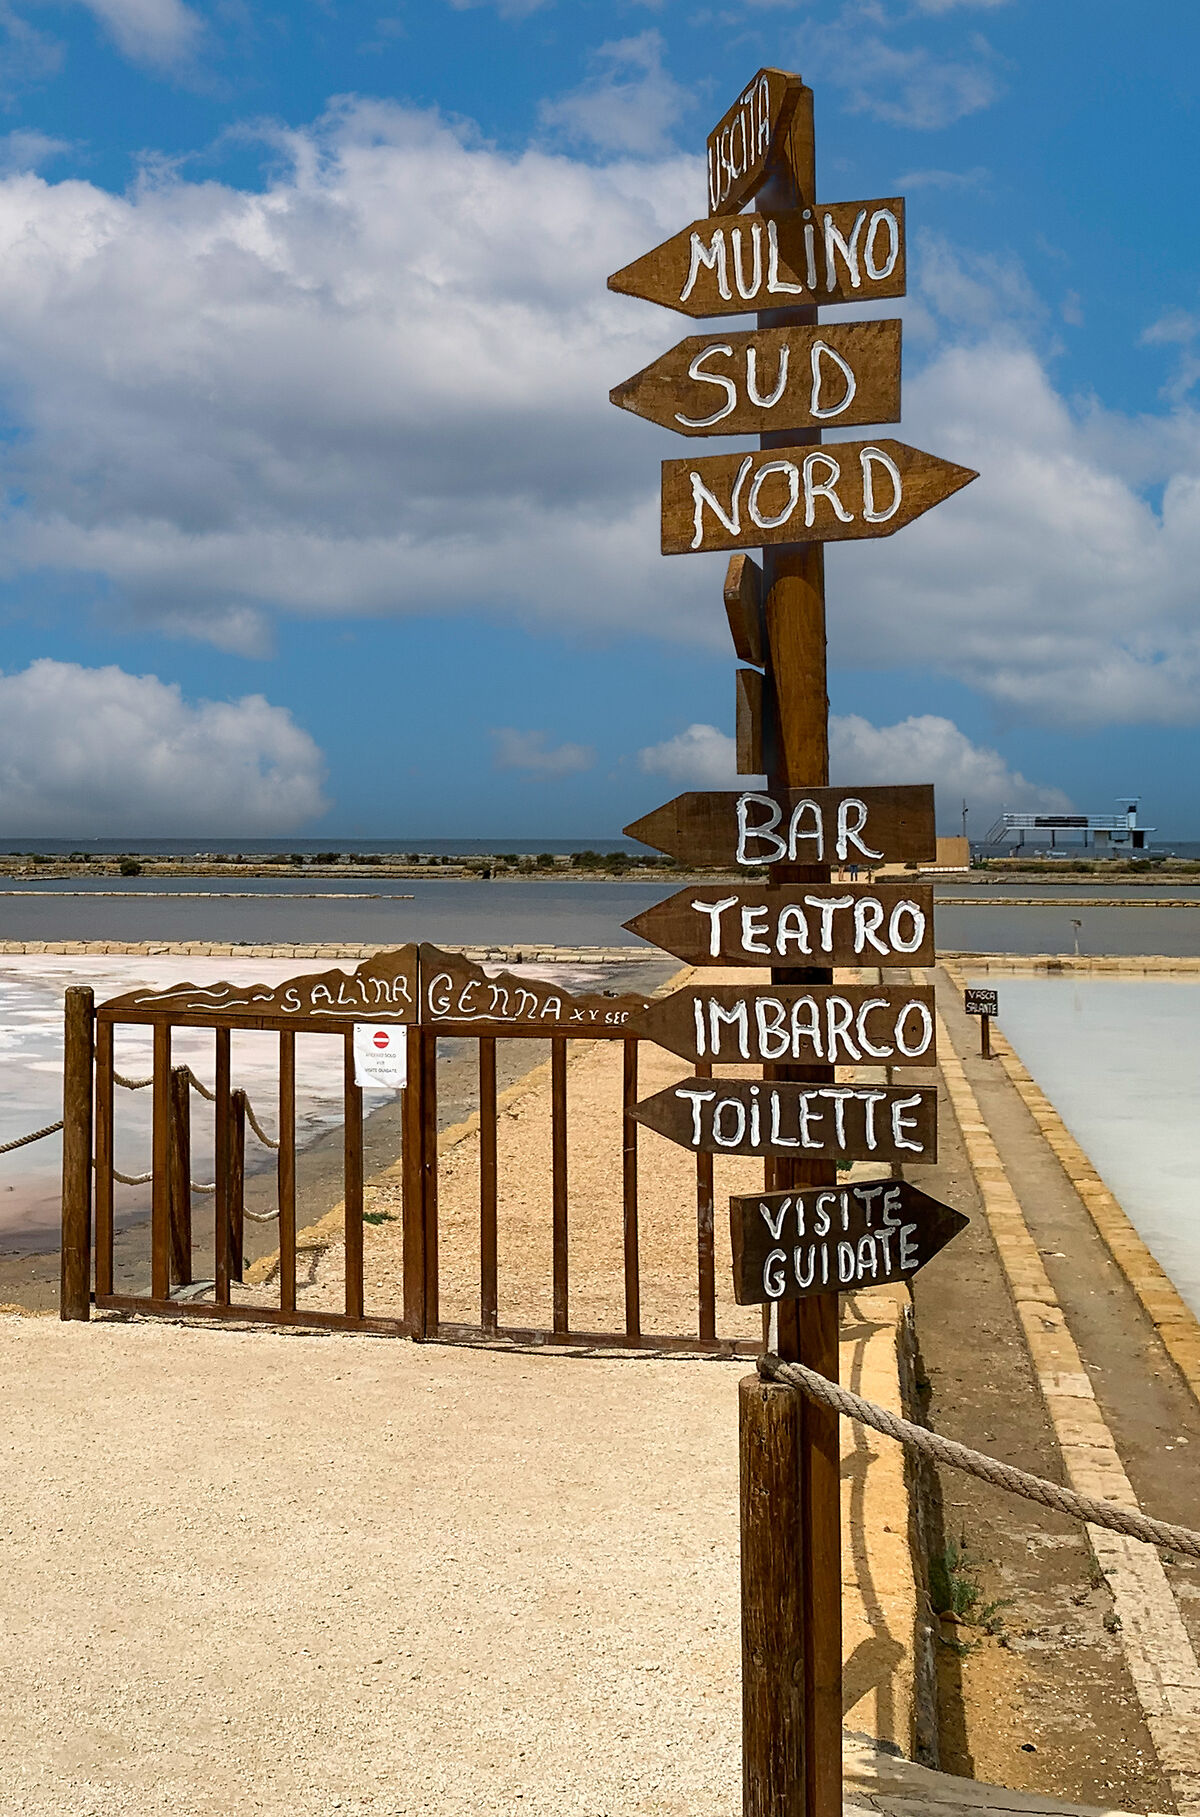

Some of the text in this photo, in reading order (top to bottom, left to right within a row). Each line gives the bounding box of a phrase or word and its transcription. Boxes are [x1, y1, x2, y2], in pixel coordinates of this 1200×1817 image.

[680, 208, 899, 302] MULiNO
[674, 340, 856, 427] SUD
[689, 447, 901, 549] NORD
[736, 792, 884, 866] BAR
[692, 895, 926, 957] TEATRO
[693, 995, 933, 1063] IMBARCO
[967, 990, 996, 1001] VASCA
[675, 1085, 924, 1151] TOiLETTE
[759, 1186, 902, 1240] VISITE
[763, 1223, 919, 1297] GUIDATE
